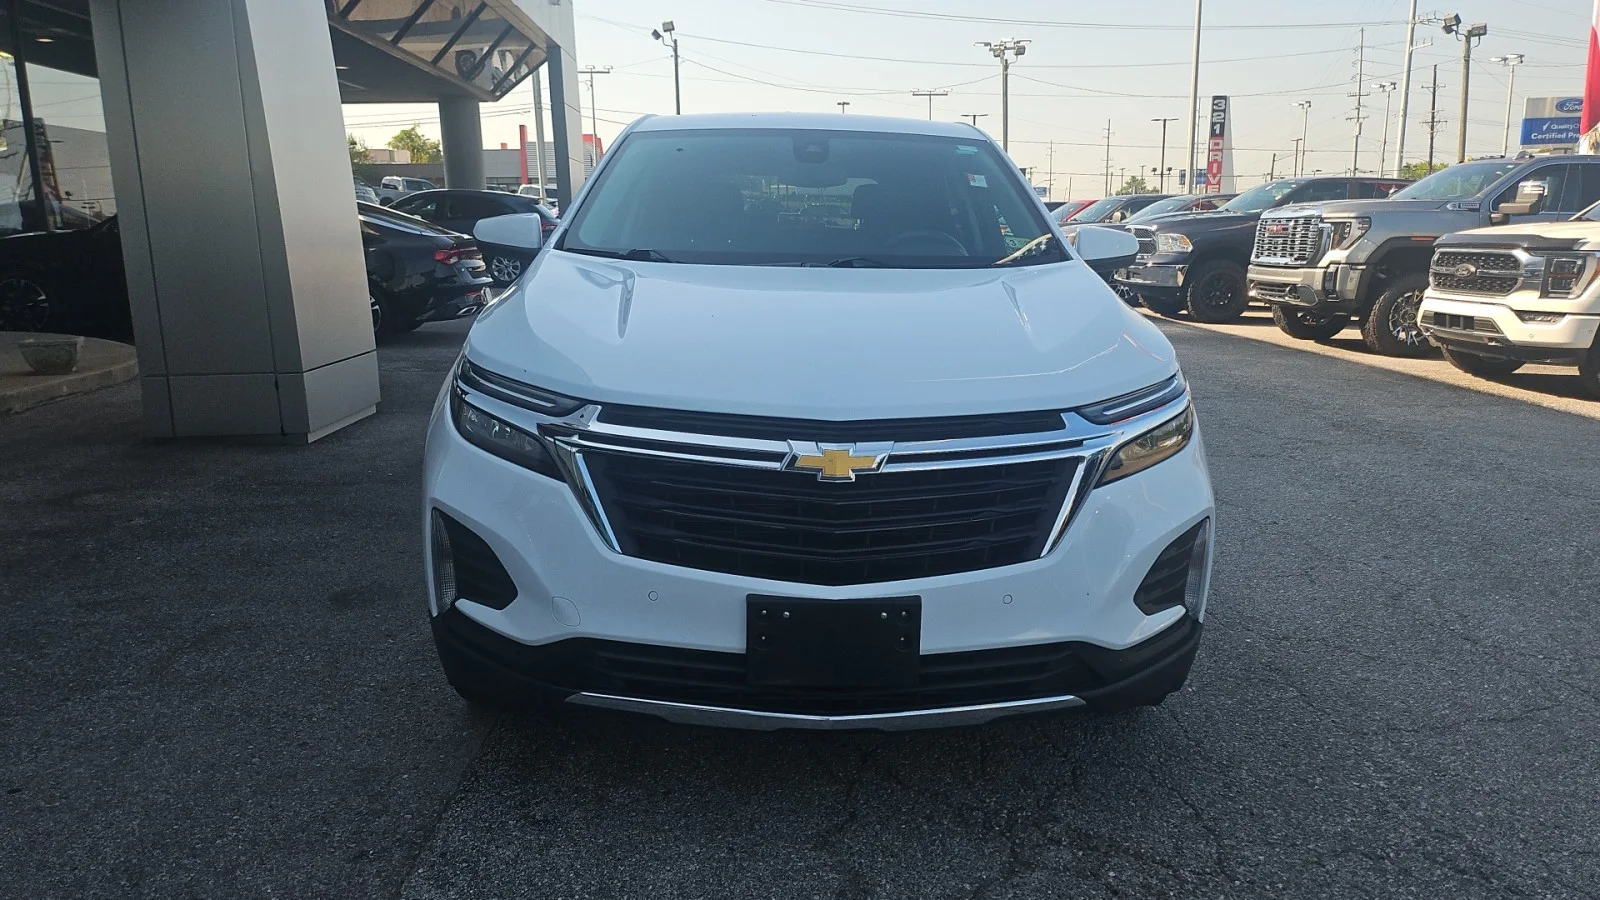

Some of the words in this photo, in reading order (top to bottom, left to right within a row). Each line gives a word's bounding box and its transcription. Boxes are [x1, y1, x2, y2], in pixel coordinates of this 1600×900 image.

[1563, 101, 1584, 111] Ford
[1212, 99, 1226, 135] 321
[1531, 132, 1566, 140] Certified
